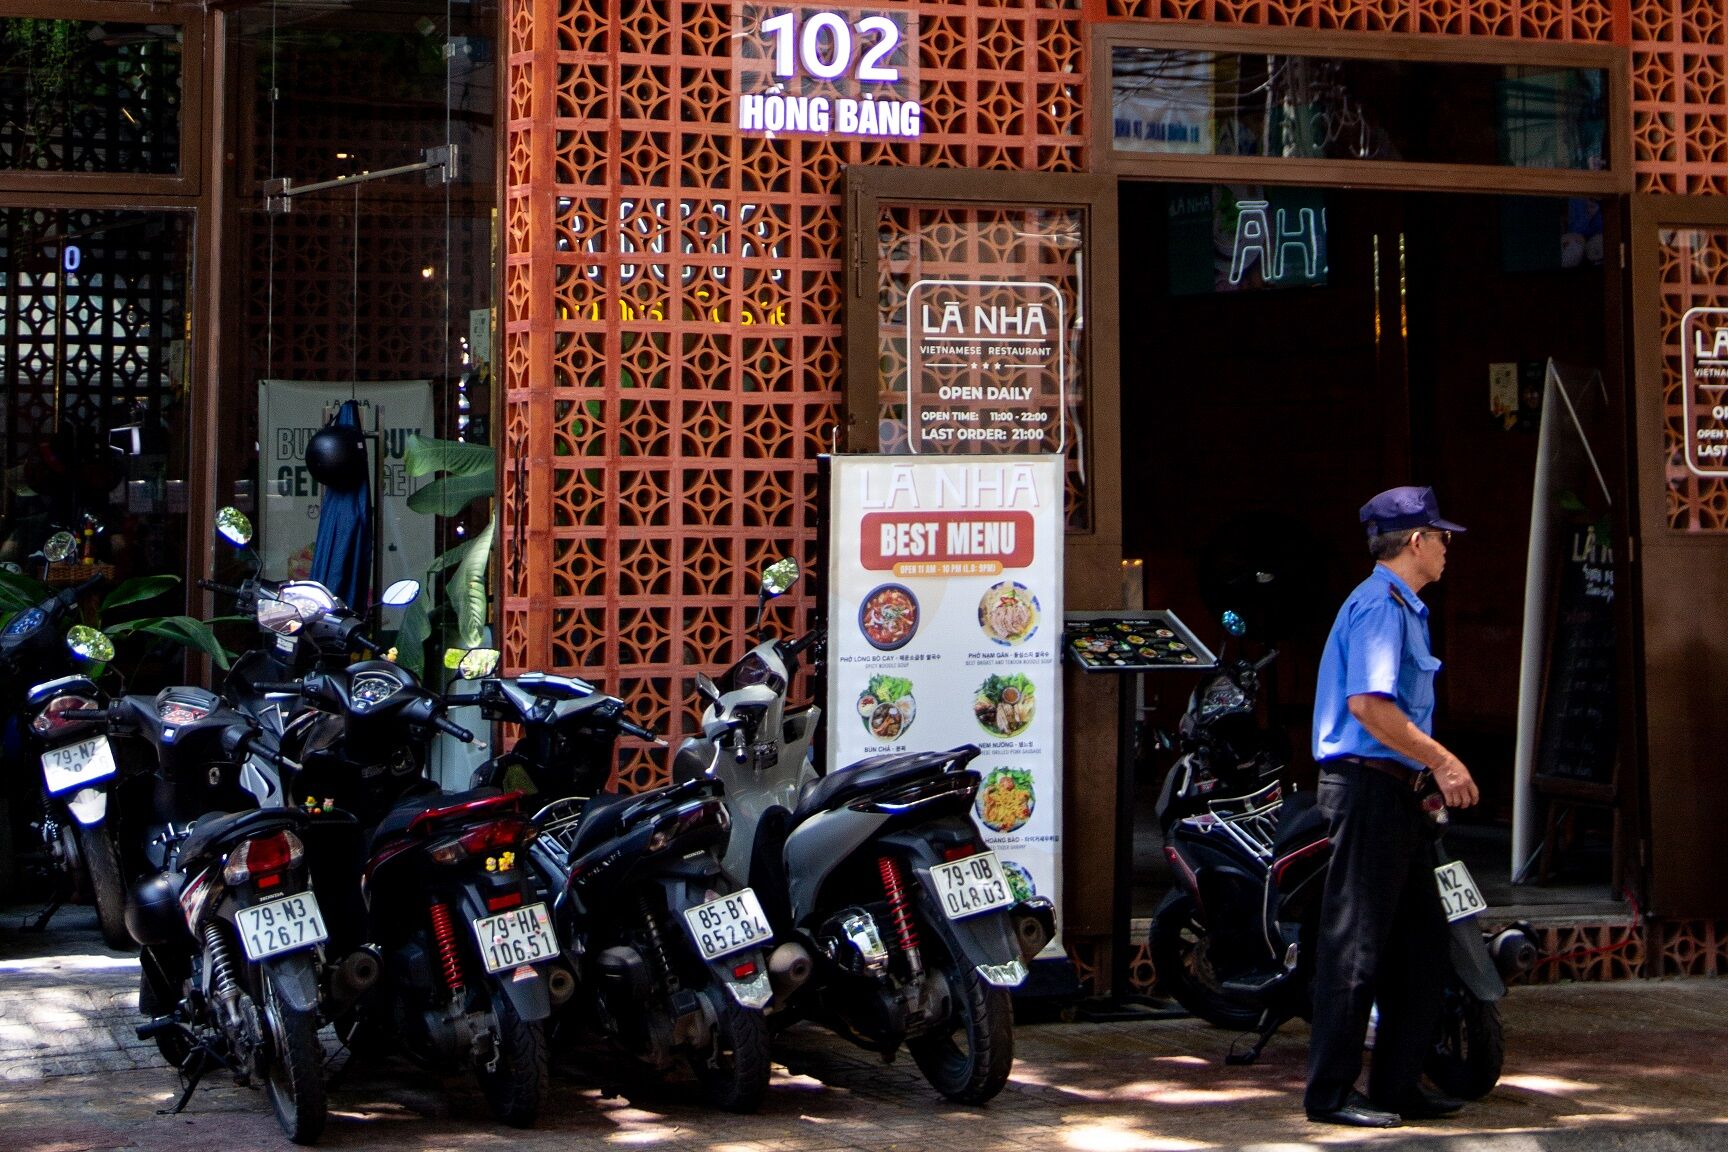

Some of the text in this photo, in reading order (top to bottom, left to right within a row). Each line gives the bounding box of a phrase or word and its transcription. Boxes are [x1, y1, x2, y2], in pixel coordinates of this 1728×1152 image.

[761, 12, 899, 80] 102
[920, 346, 1051, 356] VIETNAMESE RESTAURANT
[938, 386, 1033, 400] OPEN DAILY
[921, 411, 950, 421] OPEN
[951, 412, 979, 421] TIME:
[990, 412, 1013, 421] 11:00
[1020, 412, 1048, 422] 22:00
[921, 428, 1044, 440] LAST ORDER: 21:00
[880, 521, 1016, 557] BEST MENU
[900, 564, 917, 574] OPEN
[250, 898, 306, 931] 79-N3
[485, 908, 542, 943] 79-HA
[698, 896, 749, 929] 85-B1
[252, 917, 321, 954] 126.71
[490, 931, 552, 968] 106.51
